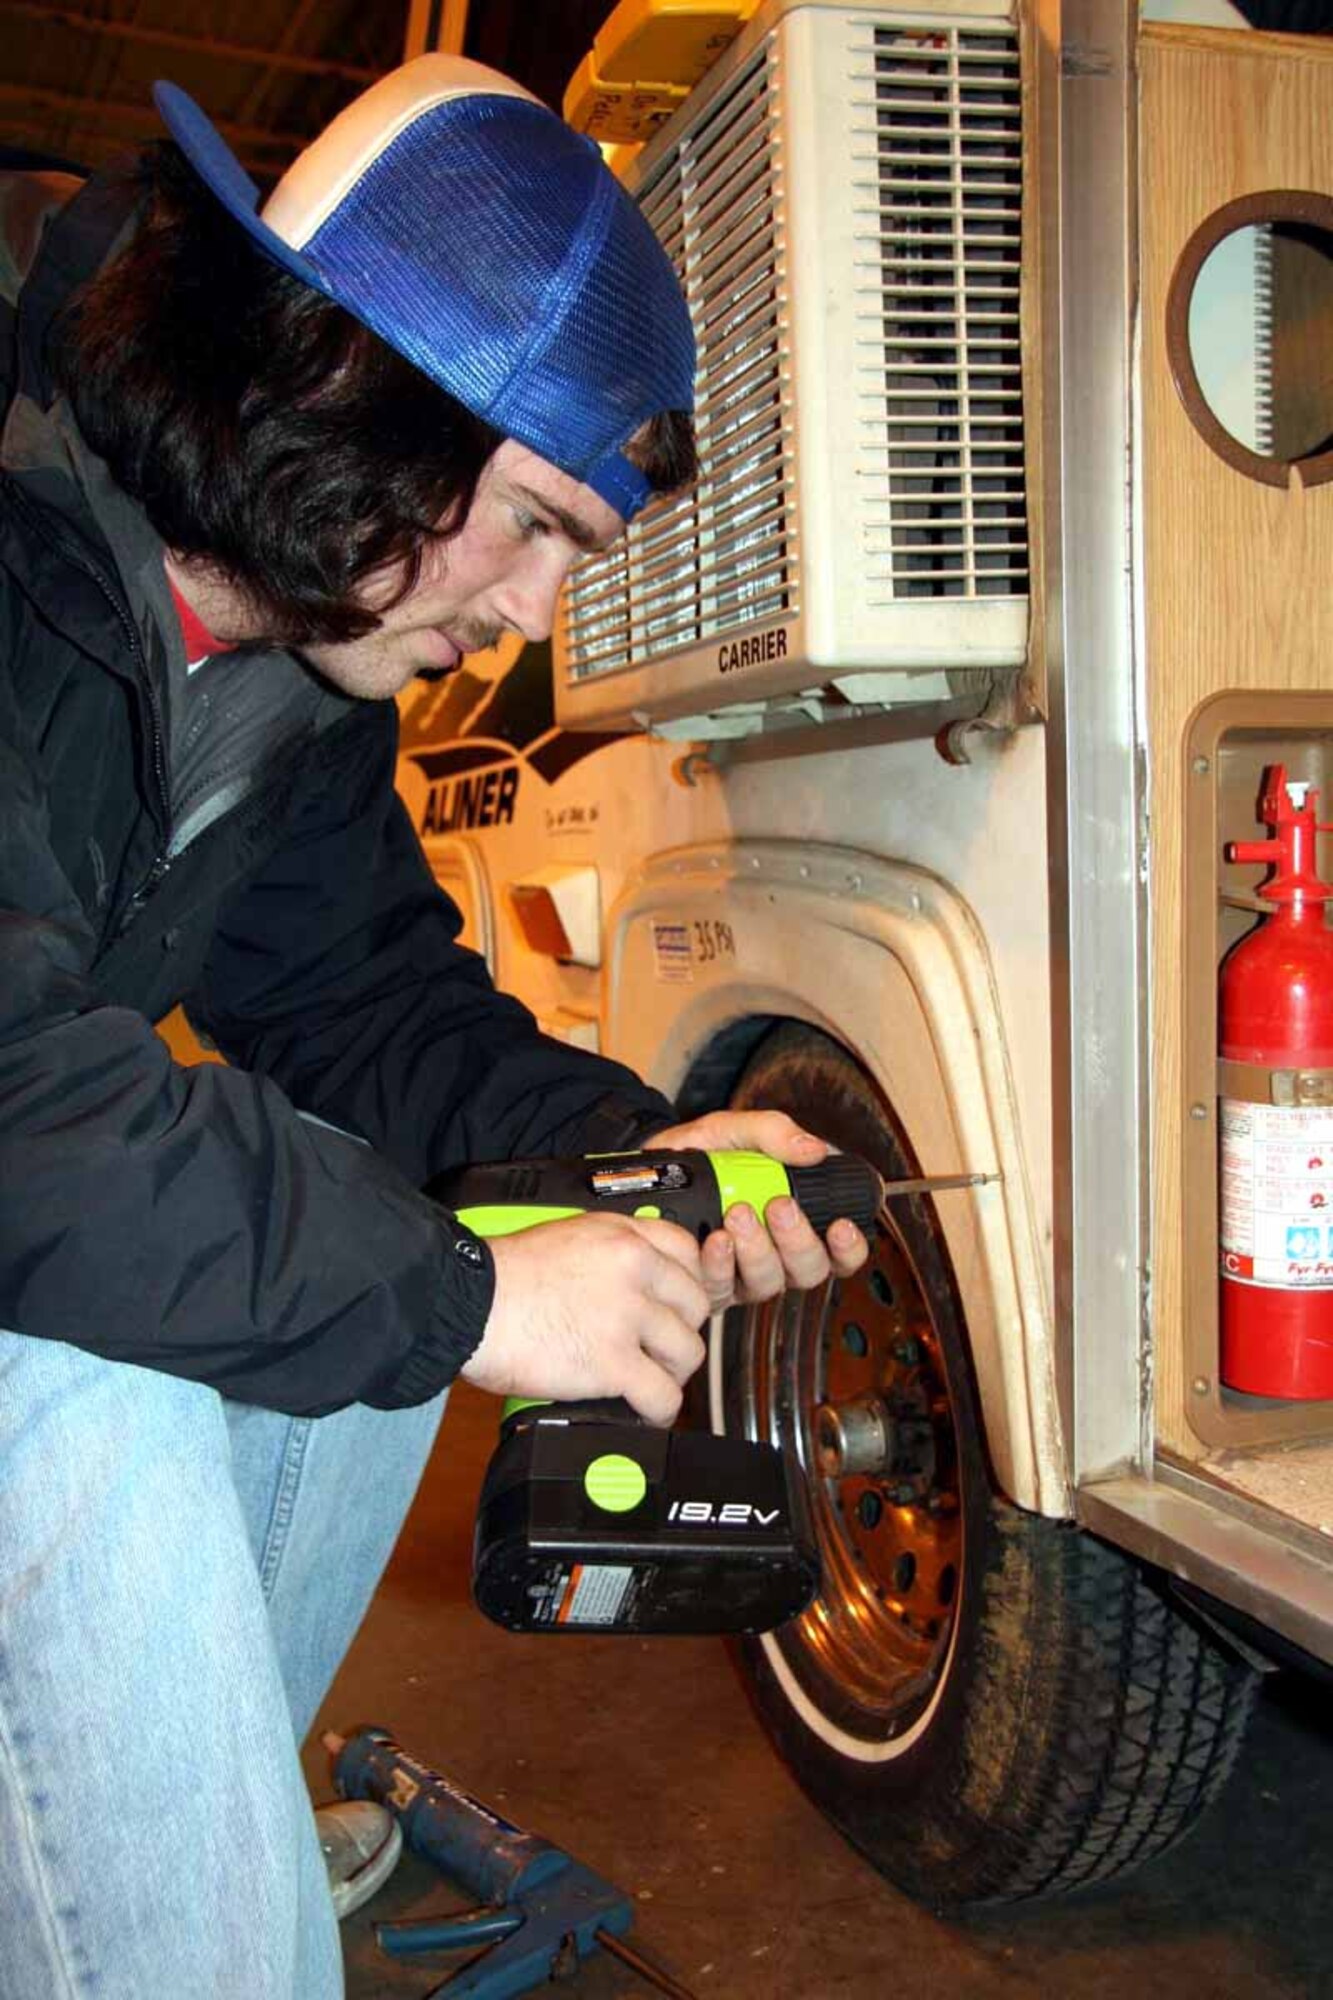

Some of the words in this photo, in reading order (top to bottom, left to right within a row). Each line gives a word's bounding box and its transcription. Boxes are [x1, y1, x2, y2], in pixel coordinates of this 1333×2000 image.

[719, 628, 787, 673] CARRIER
[420, 767, 518, 837] ALINER
[695, 920, 715, 961] 35
